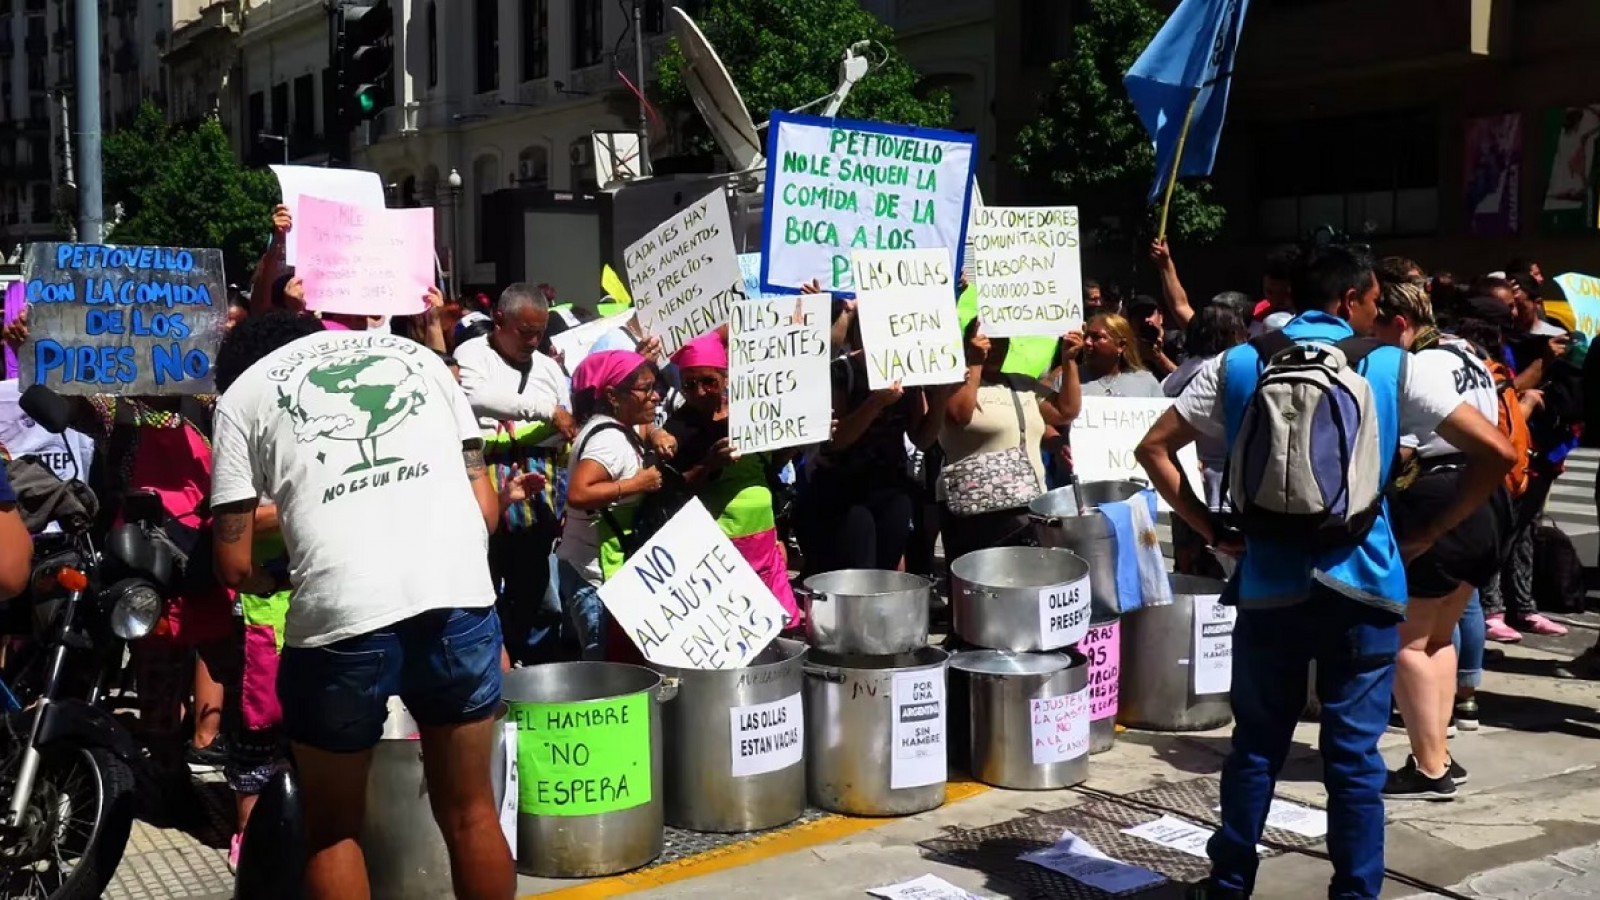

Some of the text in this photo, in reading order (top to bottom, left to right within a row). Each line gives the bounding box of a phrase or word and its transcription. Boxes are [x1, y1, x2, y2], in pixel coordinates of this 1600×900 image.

[829, 128, 943, 165] PETTOVELLO
[783, 151, 937, 192] NO LE SAQUEN LA
[783, 183, 935, 225] COMIDA DE LA
[974, 208, 1078, 228] LOS COMEDORES
[626, 202, 708, 269] CADA VES HAY
[658, 223, 719, 272] AUMENTOS
[785, 216, 916, 250] BOCA A LOS
[974, 230, 1078, 251] COMUNITARIOS
[57, 244, 194, 272] PETTOVELLO
[831, 255, 853, 288] P
[976, 251, 1056, 277] ELABORAN
[636, 292, 651, 311] DE
[656, 253, 714, 298] PRECIOS
[858, 260, 949, 291] LAS OLLAS
[1033, 281, 1057, 295] DE
[26, 278, 213, 307] CON LA COMIDA
[658, 283, 703, 322] MENOS
[86, 309, 190, 340] DE LOS
[731, 301, 779, 336] OLLAS
[889, 309, 942, 338] ESTAN
[980, 304, 1033, 323] PLATOS
[35, 338, 210, 385] PIBES NO
[731, 329, 826, 368] PRESENTES
[731, 367, 797, 402] NIÑECES
[750, 398, 782, 423] CON
[731, 416, 808, 451] HAMBRE
[38, 452, 72, 470] TEP
[1108, 448, 1138, 470] NO
[322, 483, 345, 503] NO
[349, 477, 369, 493] ES
[372, 472, 390, 488] UN
[634, 545, 676, 594] NO
[636, 545, 736, 658] AL AJUSTE
[1050, 587, 1079, 609] OLLAS
[680, 589, 750, 666] EN LAS
[703, 610, 773, 669] ESAS
[912, 690, 932, 701] UNA
[913, 681, 932, 691] POR
[515, 705, 629, 731] EL HAMBRE
[740, 706, 787, 731] LAS OLLAS
[915, 727, 930, 738] SIN
[1034, 714, 1051, 725] LA
[1056, 722, 1071, 734] NO
[552, 742, 590, 766] NO
[741, 735, 772, 757] ESTAN
[902, 734, 940, 748] HAMBRE
[537, 774, 629, 805] ESPERA
